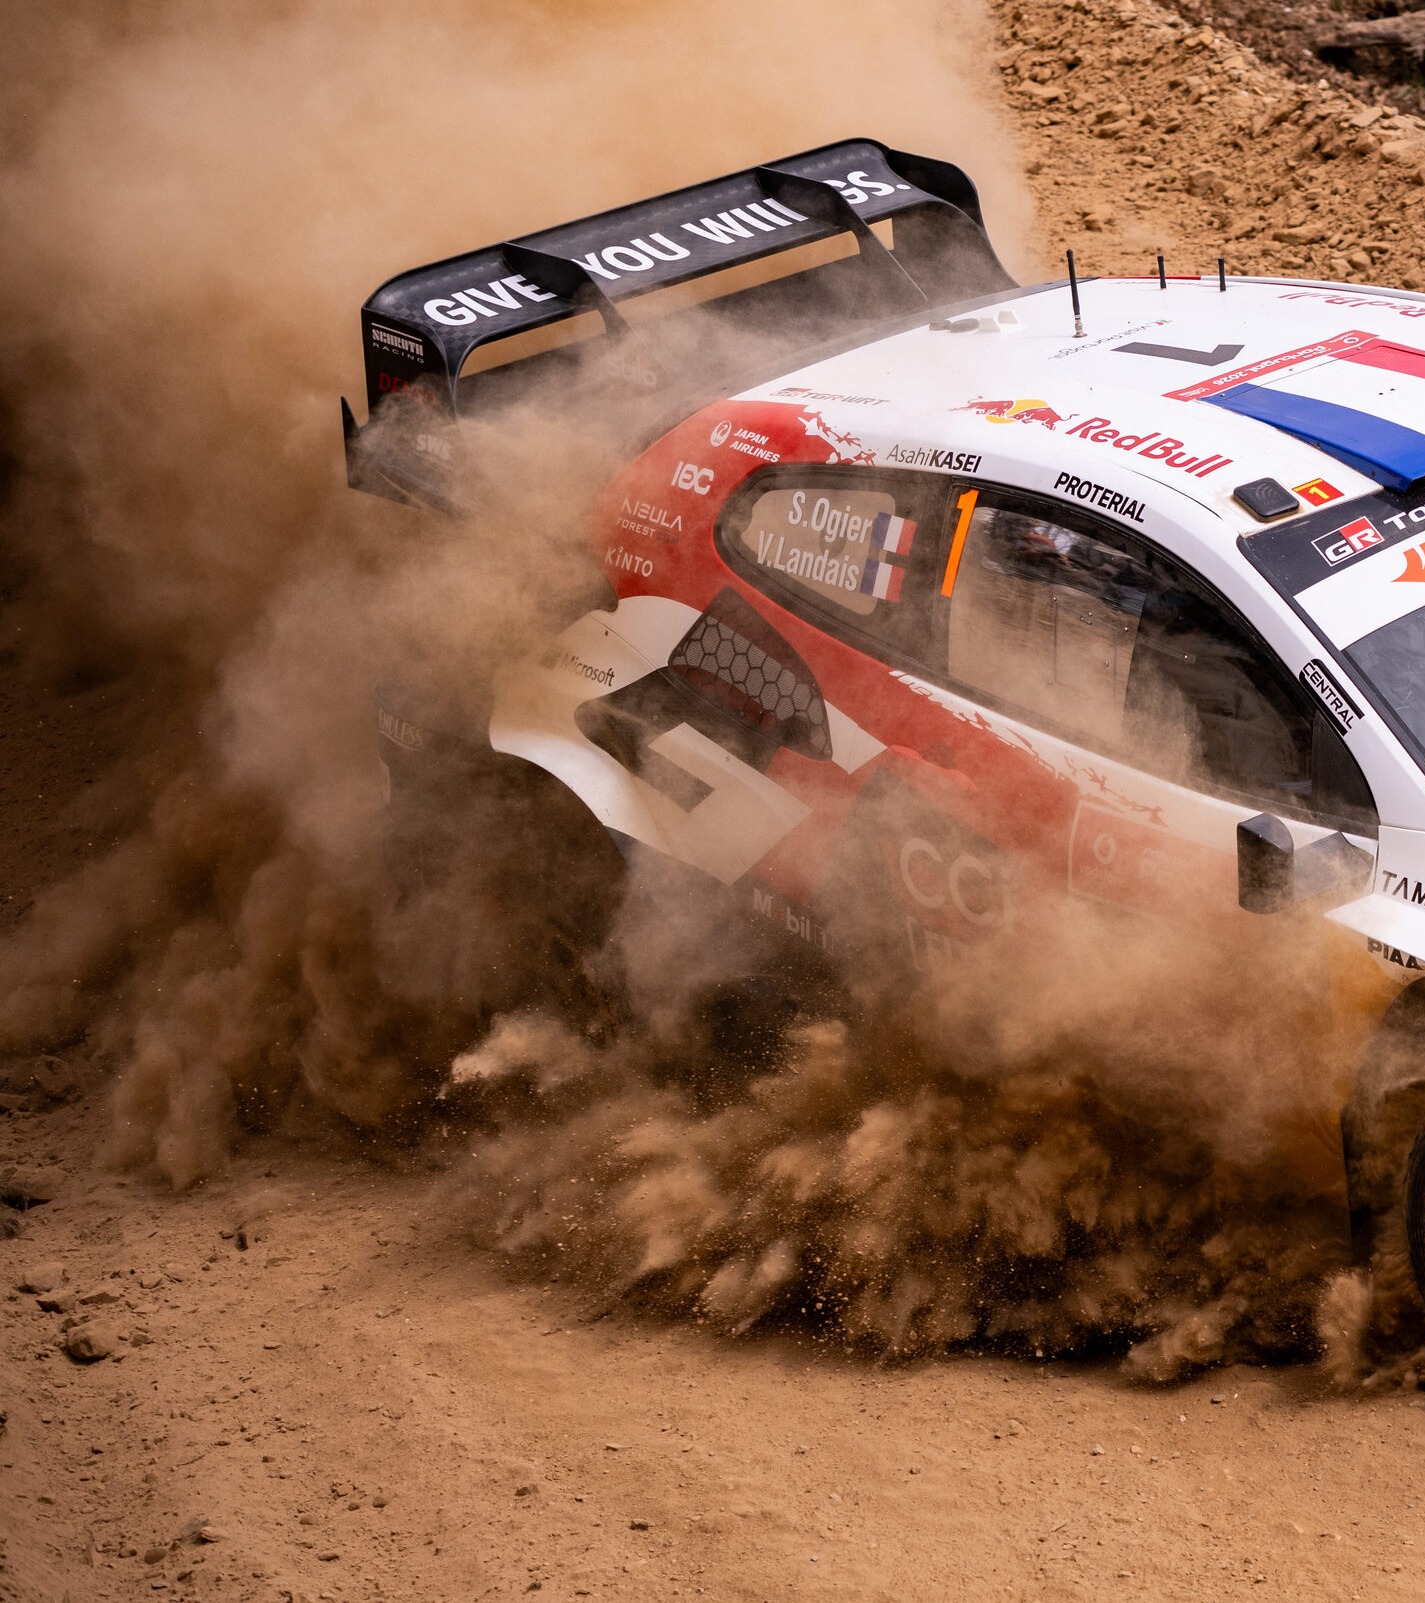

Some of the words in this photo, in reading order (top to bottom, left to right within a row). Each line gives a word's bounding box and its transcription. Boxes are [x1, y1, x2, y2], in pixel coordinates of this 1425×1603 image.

[424, 274, 557, 326] GIVE
[571, 232, 691, 280] YOU
[372, 328, 424, 357] SCHROTH
[373, 342, 425, 364] RACING
[729, 441, 781, 464] AIRLINES
[733, 428, 770, 446] JAPAN
[1053, 471, 1148, 524] PROTERIAL
[1309, 486, 1330, 500] 1
[616, 517, 657, 538] FOREST
[1324, 522, 1383, 565] GR
[940, 490, 980, 598] 1
[560, 652, 616, 687] Microsoft
[1301, 660, 1354, 731] CENTRAL
